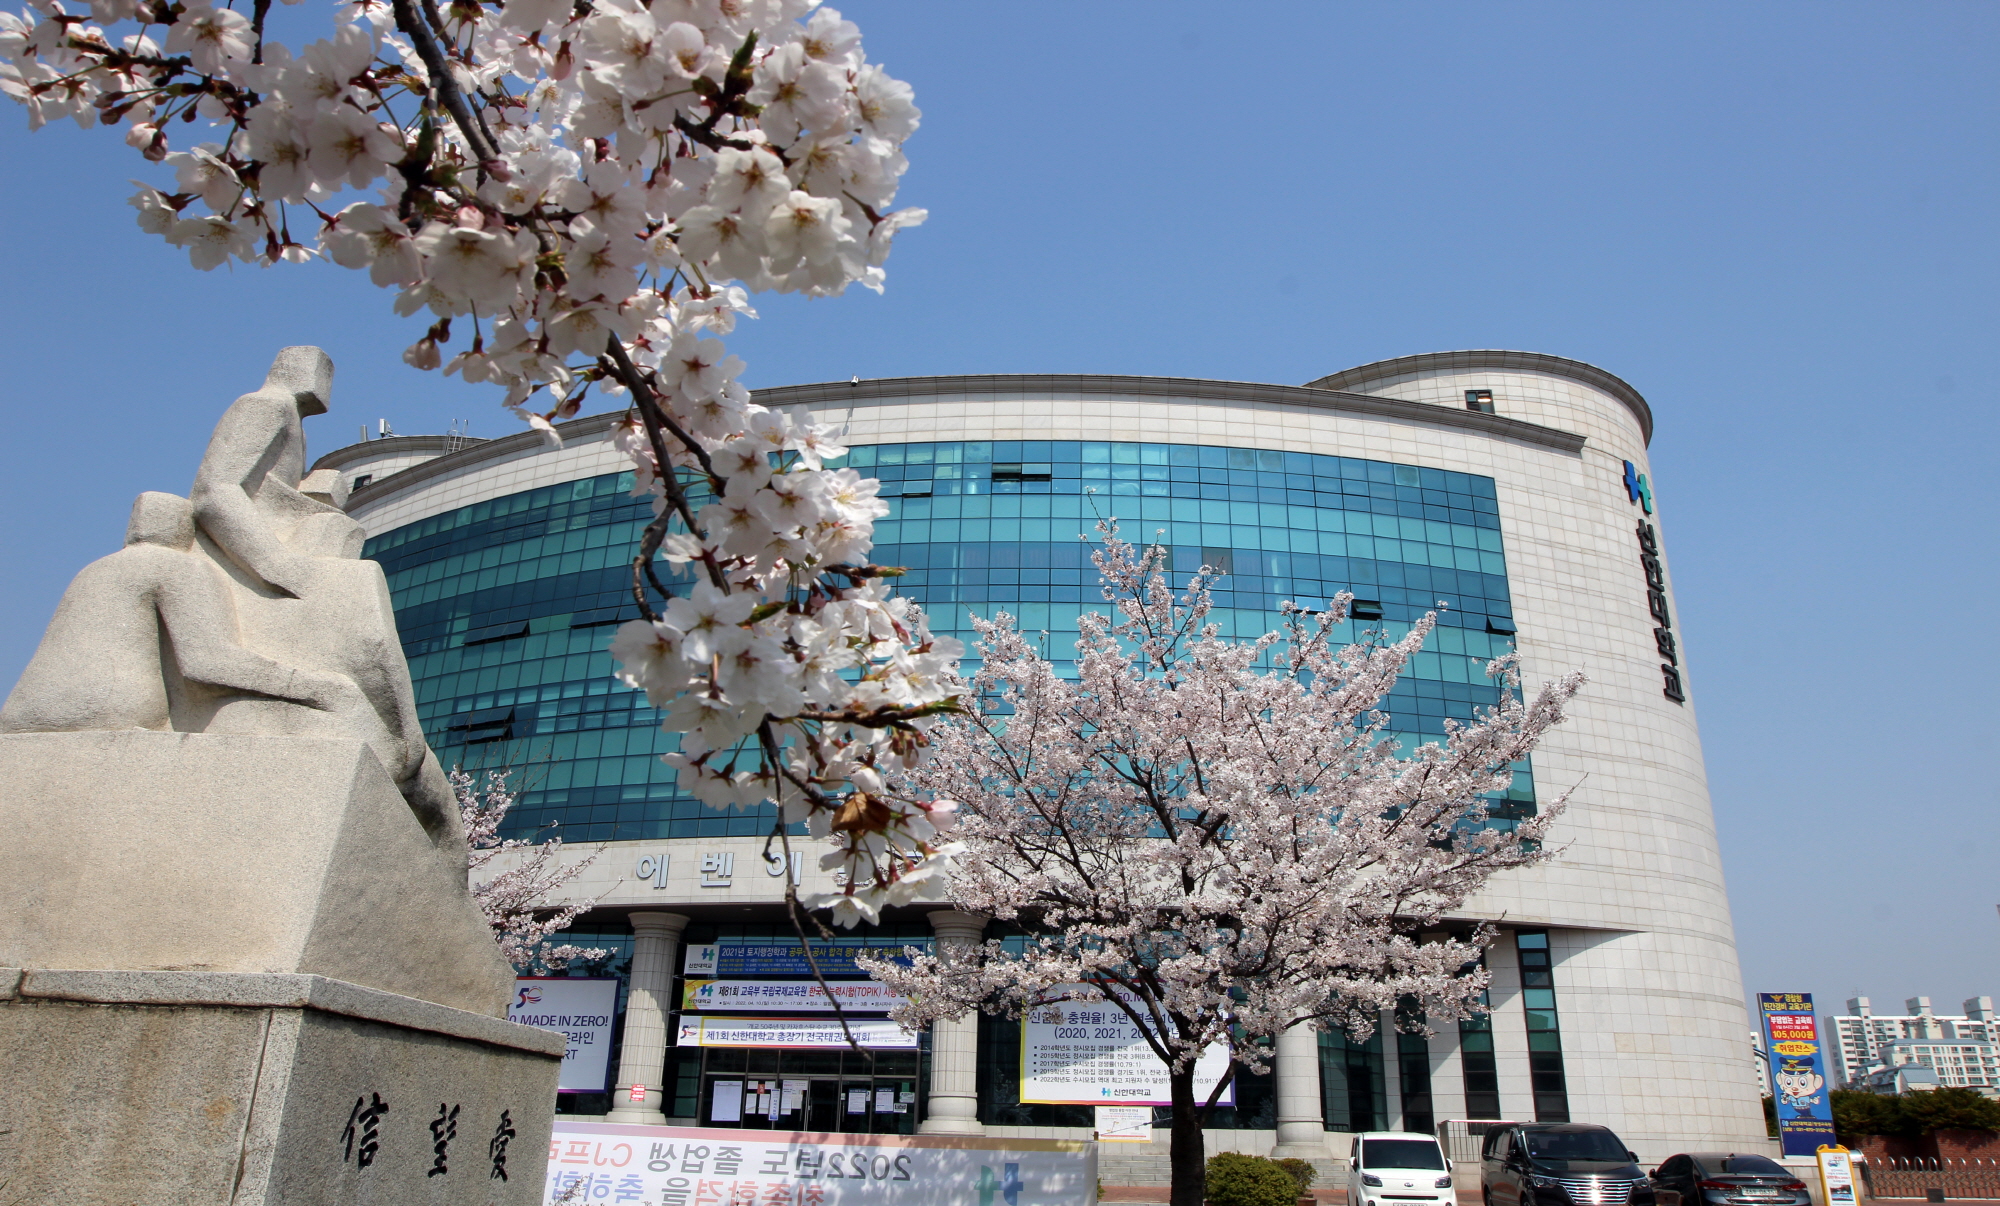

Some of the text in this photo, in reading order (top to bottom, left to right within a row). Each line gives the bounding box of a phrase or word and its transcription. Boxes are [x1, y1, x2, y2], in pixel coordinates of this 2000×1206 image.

[1636, 518, 1686, 703] 신한대학교
[721, 947, 745, 957] 2021년
[746, 947, 787, 957] 토지행정학과
[718, 986, 740, 997] 제81회
[740, 986, 760, 996] 교육부
[761, 985, 808, 997] 국립국제교육원
[1788, 1003, 1813, 1011] 교육기관
[558, 1015, 571, 1027] IN
[572, 1015, 609, 1027] ZERO!
[1067, 1011, 1106, 1025] 충원율!
[1110, 1012, 1129, 1025] 3년
[1770, 1015, 1813, 1025] 부담없는 교육비
[706, 1030, 729, 1041] 제1회
[731, 1030, 775, 1042] 신한대학교
[777, 1031, 804, 1042] 총장기
[1054, 1026, 1090, 1040] (2020,
[1094, 1027, 1126, 1040] 2021,
[1772, 1030, 1815, 1040] 105,000원
[1040, 1044, 1071, 1052] 2014학년도
[1073, 1044, 1096, 1052] 정시모집
[1040, 1052, 1071, 1060] 2015학년도
[1073, 1052, 1096, 1060] 정시모집
[1073, 1068, 1096, 1076] 정시모집
[1073, 1076, 1096, 1084] 수시모집
[1113, 1088, 1151, 1097] 신한대학교
